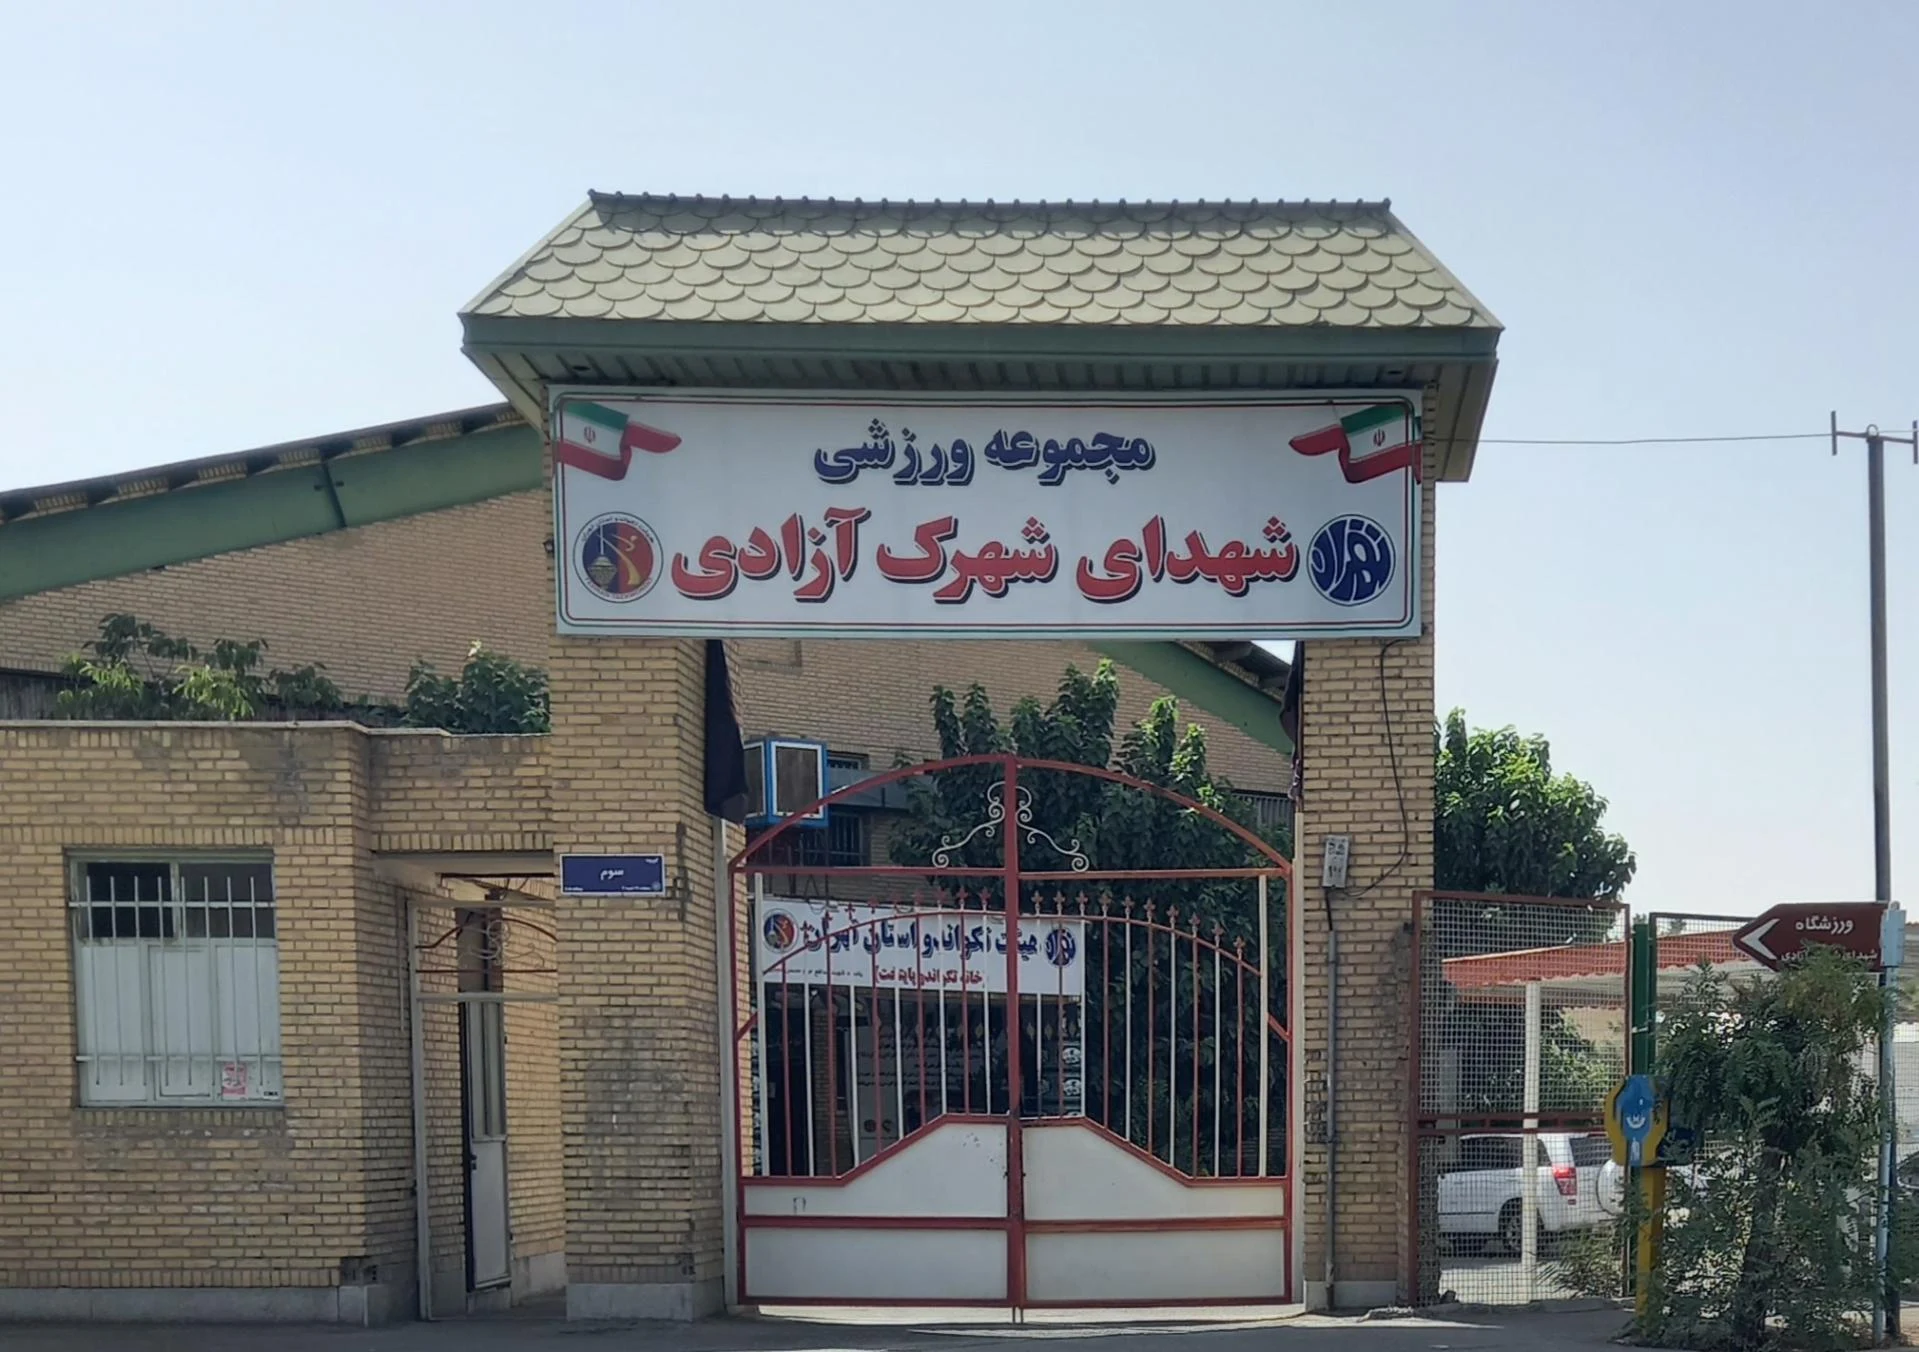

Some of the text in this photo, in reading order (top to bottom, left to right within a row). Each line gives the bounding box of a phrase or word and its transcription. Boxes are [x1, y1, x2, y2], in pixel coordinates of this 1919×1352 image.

[813, 418, 1156, 486] مجموعه ورزشی
[671, 506, 1300, 605] شهدای شهرک آزادی
[599, 868, 624, 881] سوم
[863, 919, 918, 954] استان
[1795, 914, 1854, 935] ورزشگاه
